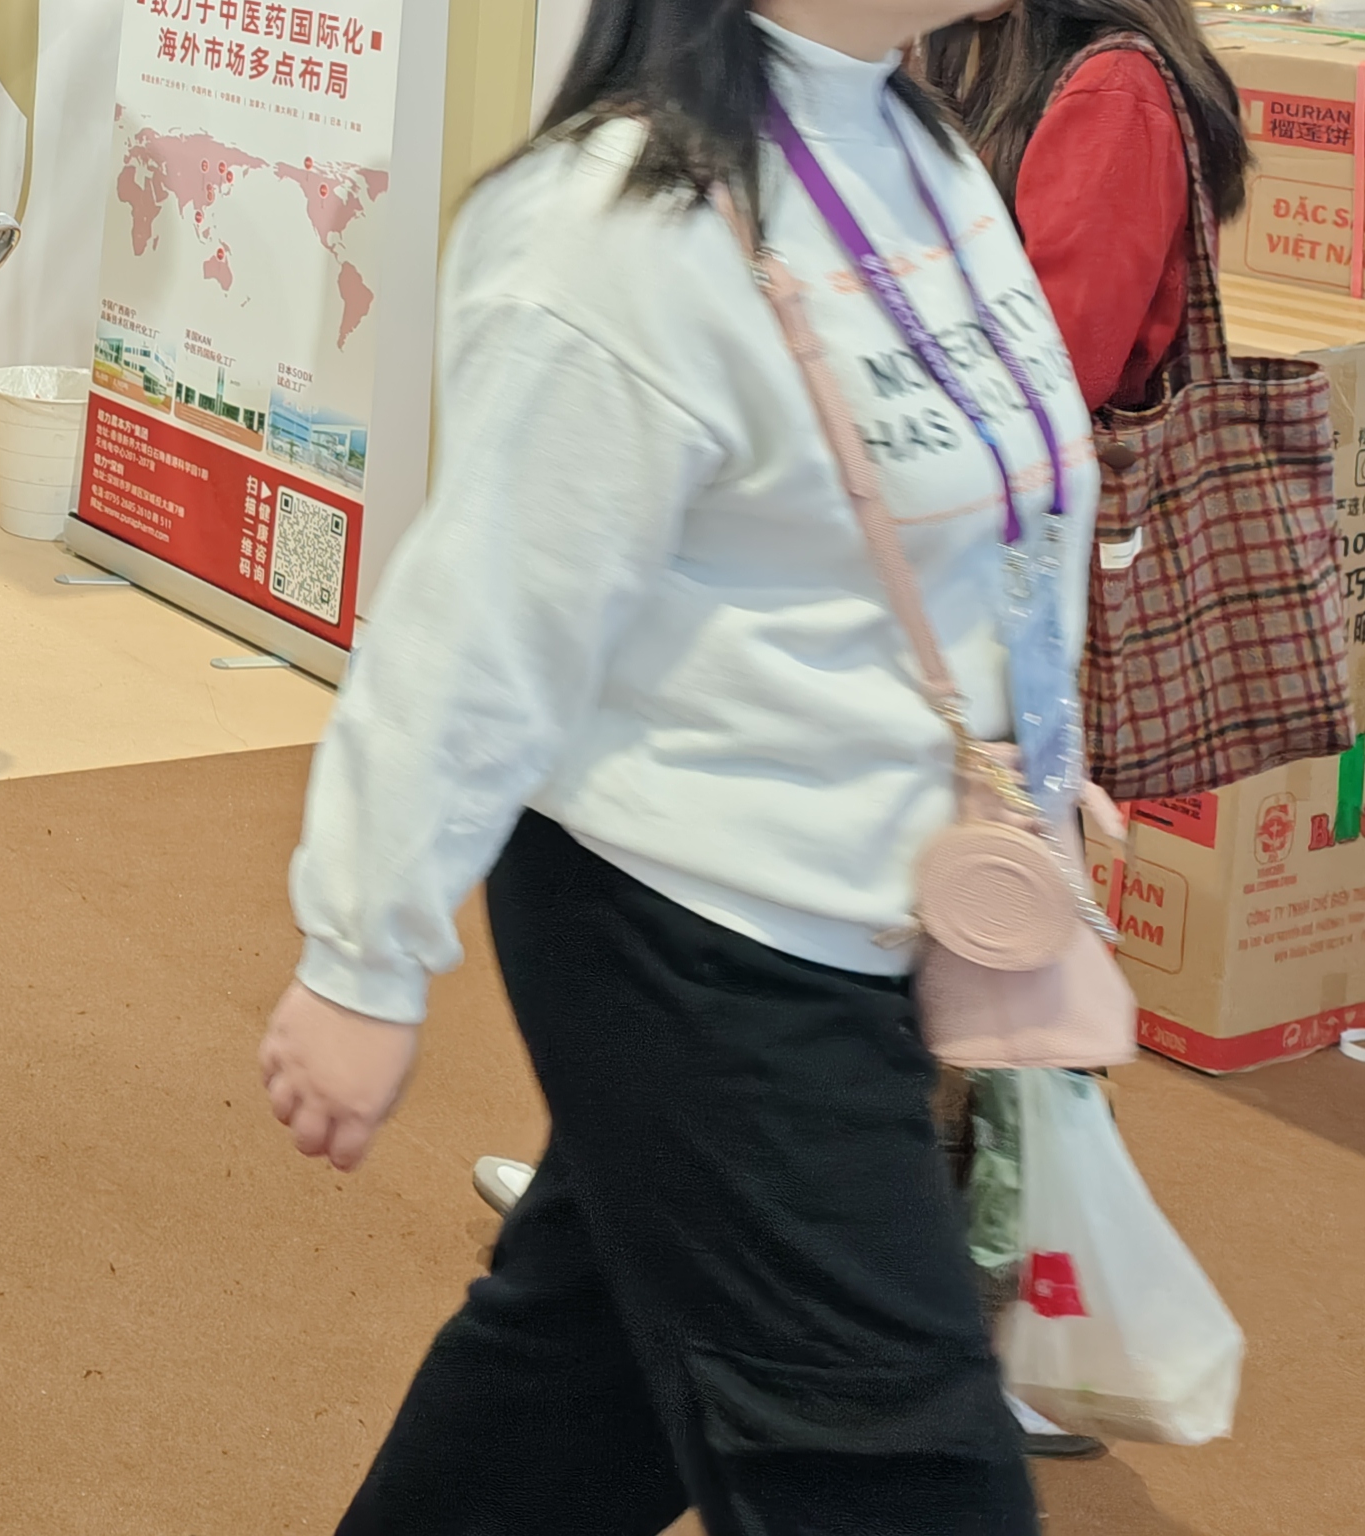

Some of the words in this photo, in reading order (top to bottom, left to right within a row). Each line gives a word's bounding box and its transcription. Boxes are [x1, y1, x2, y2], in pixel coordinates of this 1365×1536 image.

[157, 27, 349, 100] 海外市场多点布局
[1270, 100, 1352, 124] DURIAN
[1273, 195, 1330, 228] ĐẶC
[1266, 232, 1321, 263] VIỆT
[239, 474, 259, 579] 扫描二维码
[253, 501, 271, 585] 健康咨询
